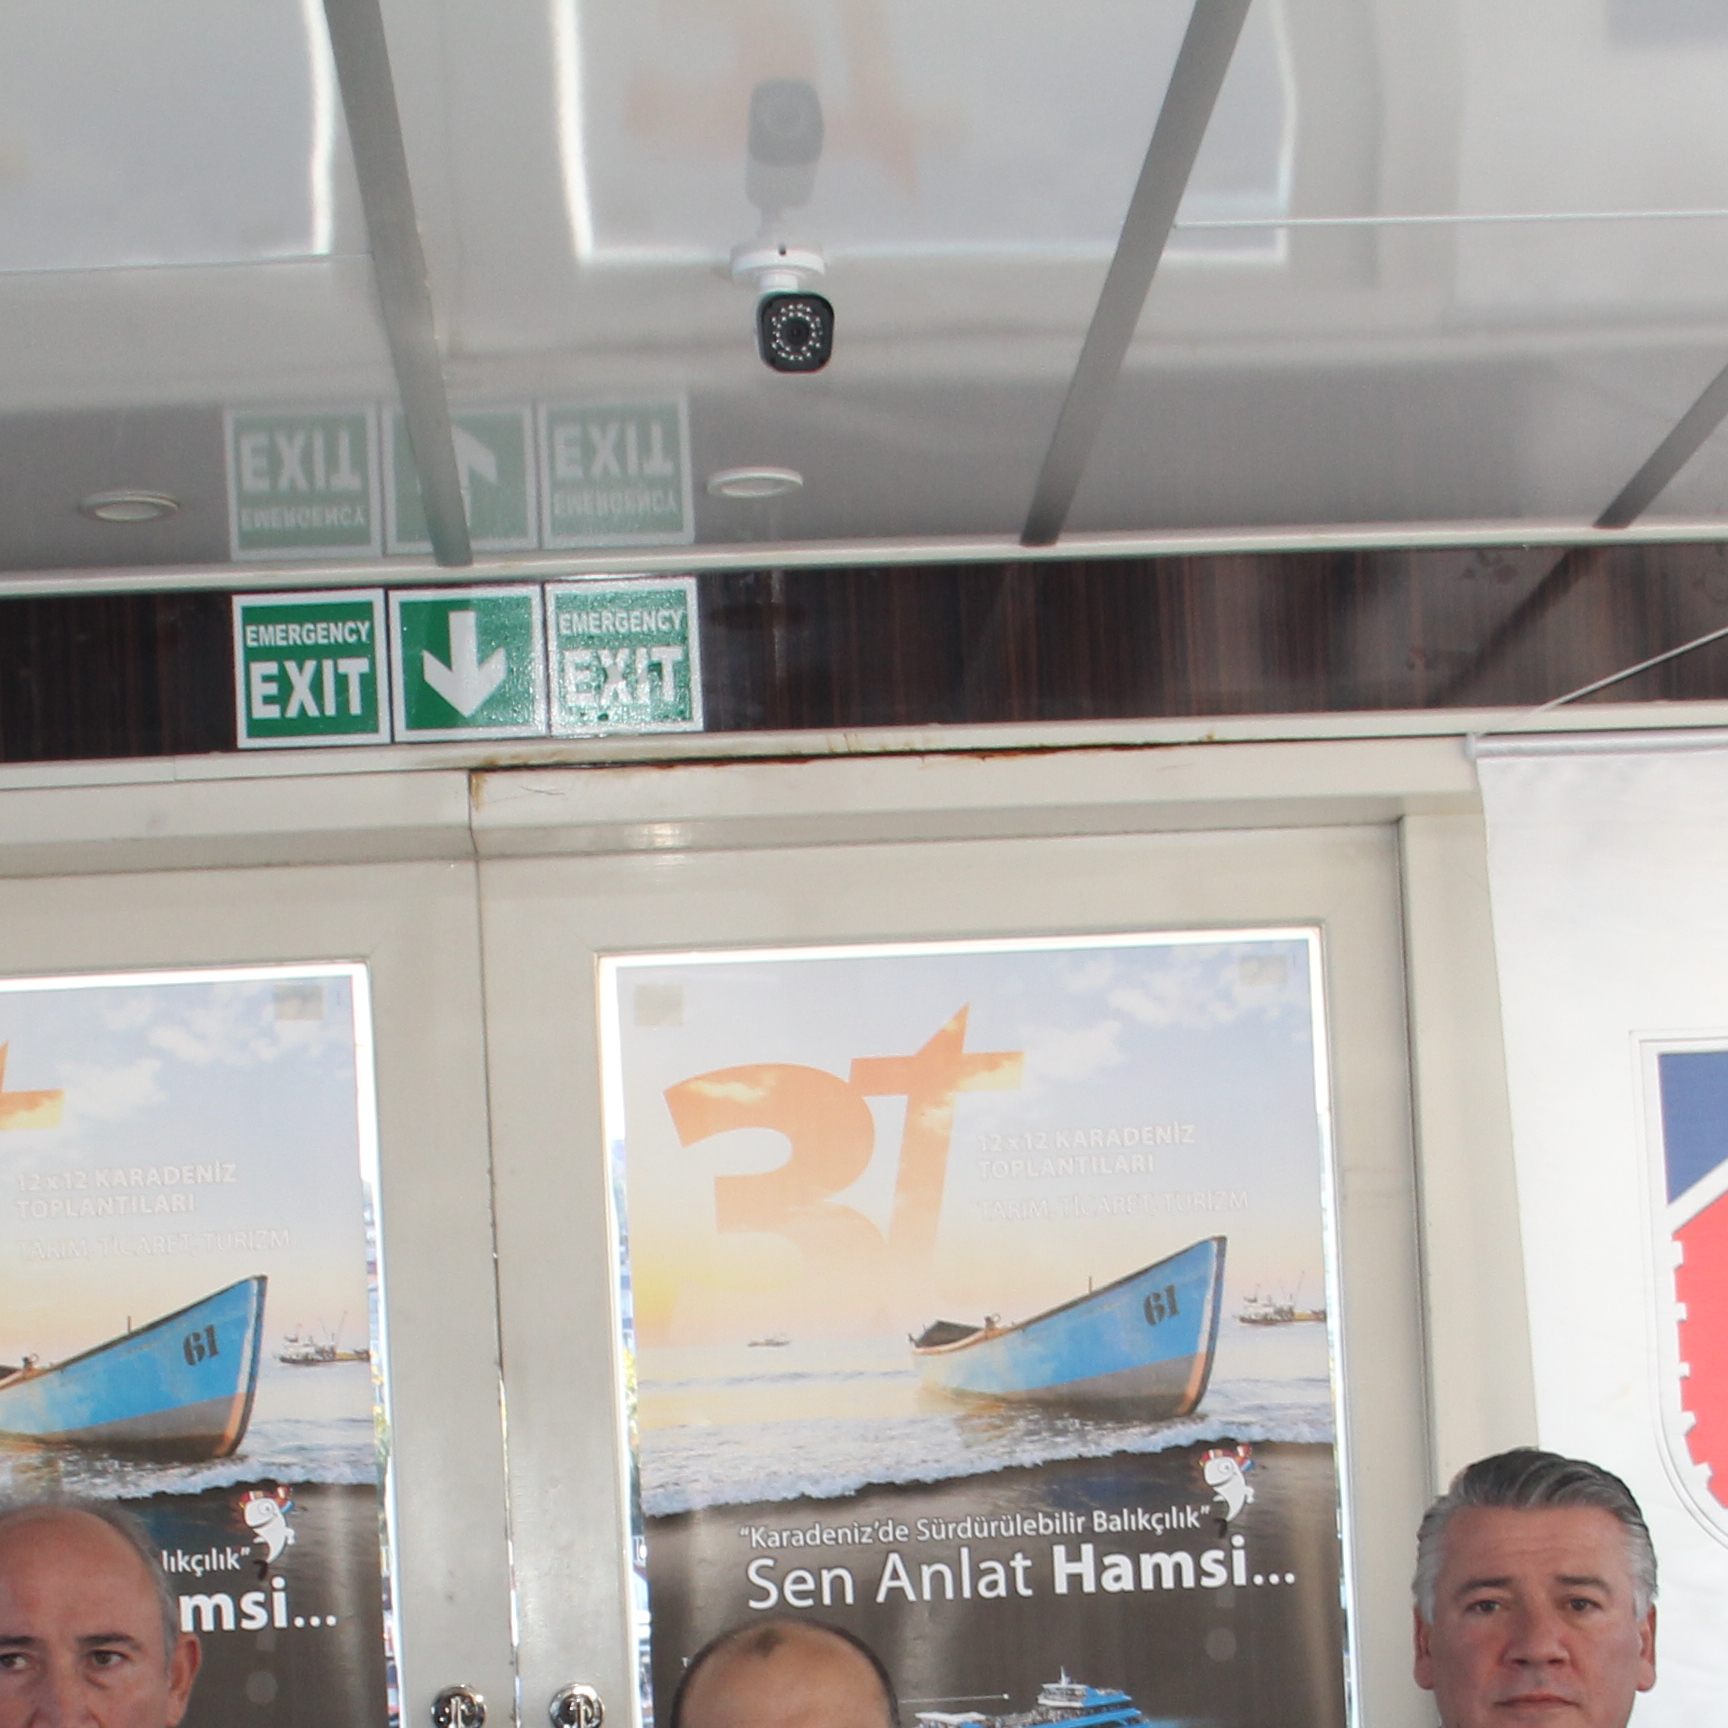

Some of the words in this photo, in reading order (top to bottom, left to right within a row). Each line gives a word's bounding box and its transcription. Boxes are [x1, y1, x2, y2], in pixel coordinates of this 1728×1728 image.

[245, 619, 371, 647] EMERGENCY
[558, 609, 685, 636] EMERGENCY
[248, 656, 370, 719] EXIT
[561, 644, 684, 706] EXIT
[1054, 1120, 1196, 1150] KARADENİZ
[94, 1159, 238, 1189] KARADENİZ
[977, 1153, 1155, 1180] TOPLANTILARI
[15, 1192, 196, 1221] TOPLANTILARI
[1144, 1284, 1181, 1327] 61
[183, 1324, 220, 1367] 61
[915, 1512, 1086, 1543] Sürdürülebilir
[747, 1557, 856, 1610] Sen
[876, 1546, 1034, 1603] Anlat
[1050, 1534, 1296, 1596] Hamsi...
